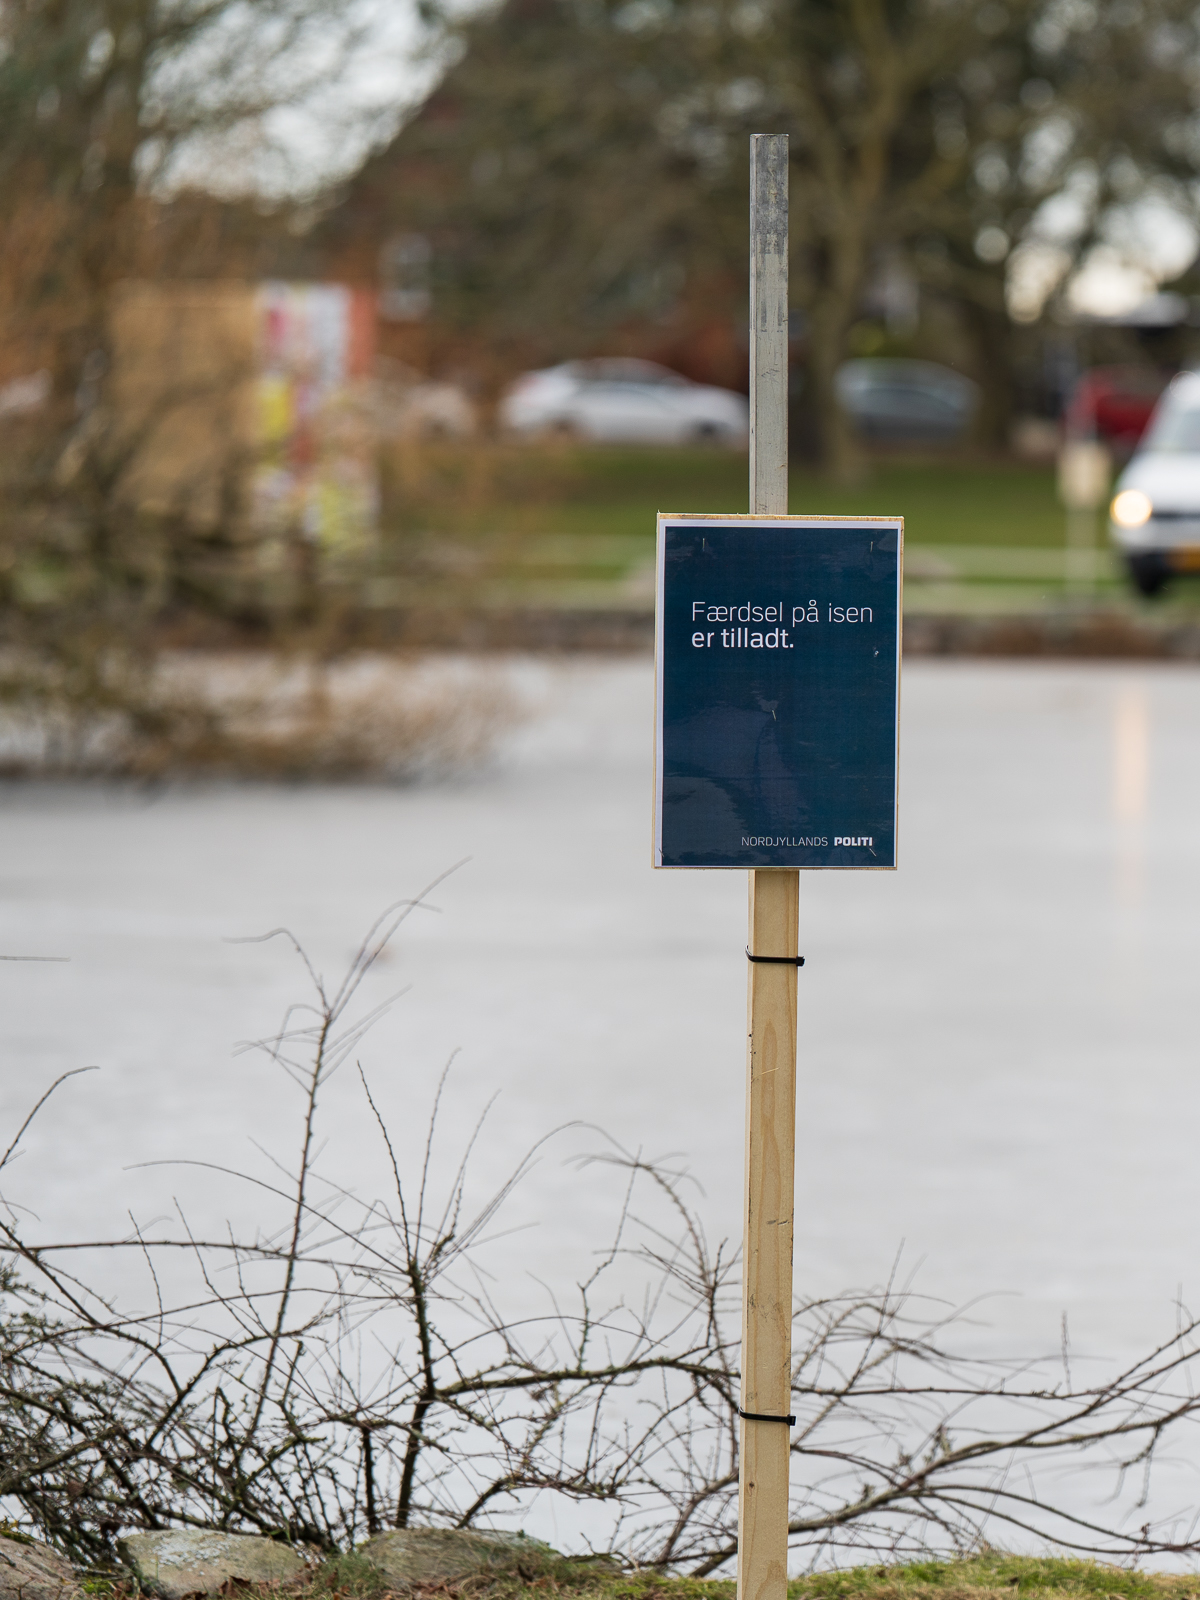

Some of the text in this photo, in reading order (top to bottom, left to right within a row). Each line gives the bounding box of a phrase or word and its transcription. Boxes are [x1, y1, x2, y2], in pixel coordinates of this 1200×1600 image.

[691, 599, 873, 628] Færdsel på isen
[691, 628, 794, 649] er tilladt.
[741, 836, 873, 847] NORDJYLLANDS POLITI
